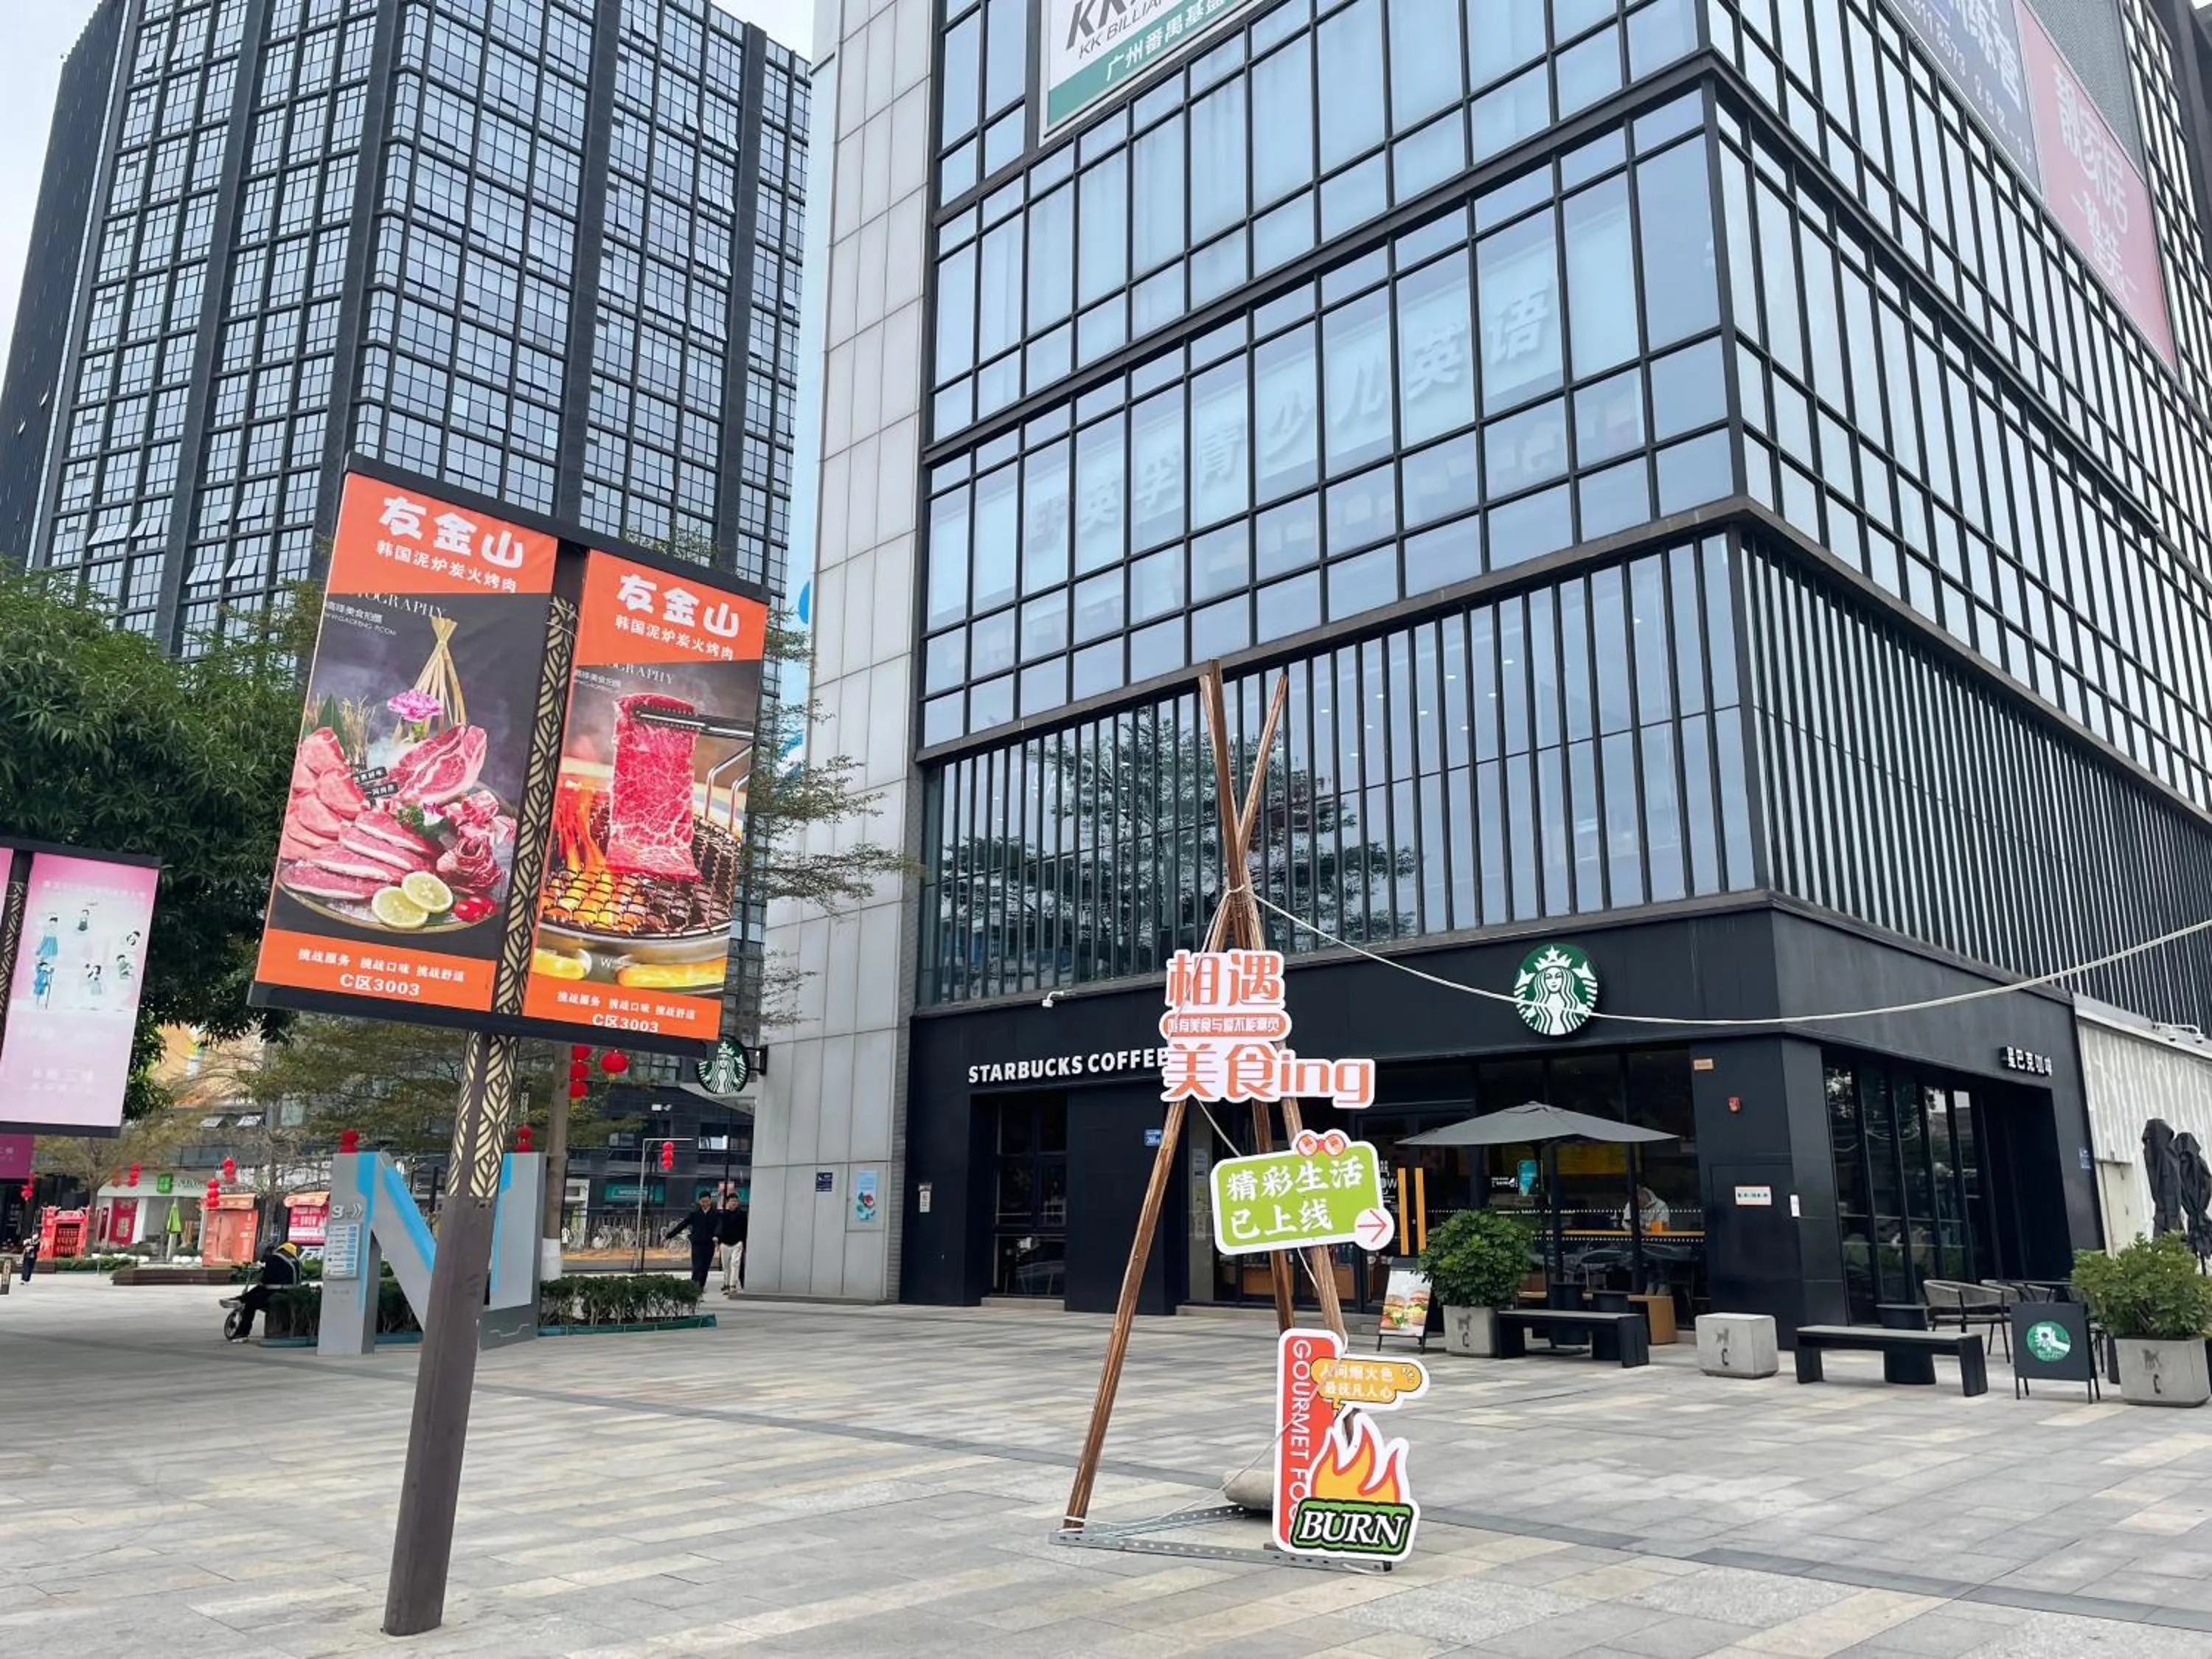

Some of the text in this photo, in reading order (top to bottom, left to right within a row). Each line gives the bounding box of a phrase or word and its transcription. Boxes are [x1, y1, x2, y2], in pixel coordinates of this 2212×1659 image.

[378, 496, 523, 568] 友金山
[376, 540, 517, 593] 韩国泥炉炭火烤肉
[616, 574, 739, 638] 友金山
[615, 614, 734, 661] 韩国泥炉炭火烤肉
[298, 948, 349, 967] 挑战服务
[360, 957, 410, 975] 挑战口味
[1169, 953, 1281, 1007] 相遇
[340, 973, 420, 996] C区3003
[557, 991, 600, 1007] 挑战服务
[609, 998, 650, 1013] 挑战口味
[592, 1014, 659, 1033] C区3003
[968, 1047, 1170, 1083] STARBUCKS COFFEE
[1226, 1155, 1364, 1201] 精彩生活
[1231, 1197, 1334, 1239] 已上线
[1290, 1339, 1312, 1460] GOURMET
[1298, 1511, 1407, 1547] BURN
